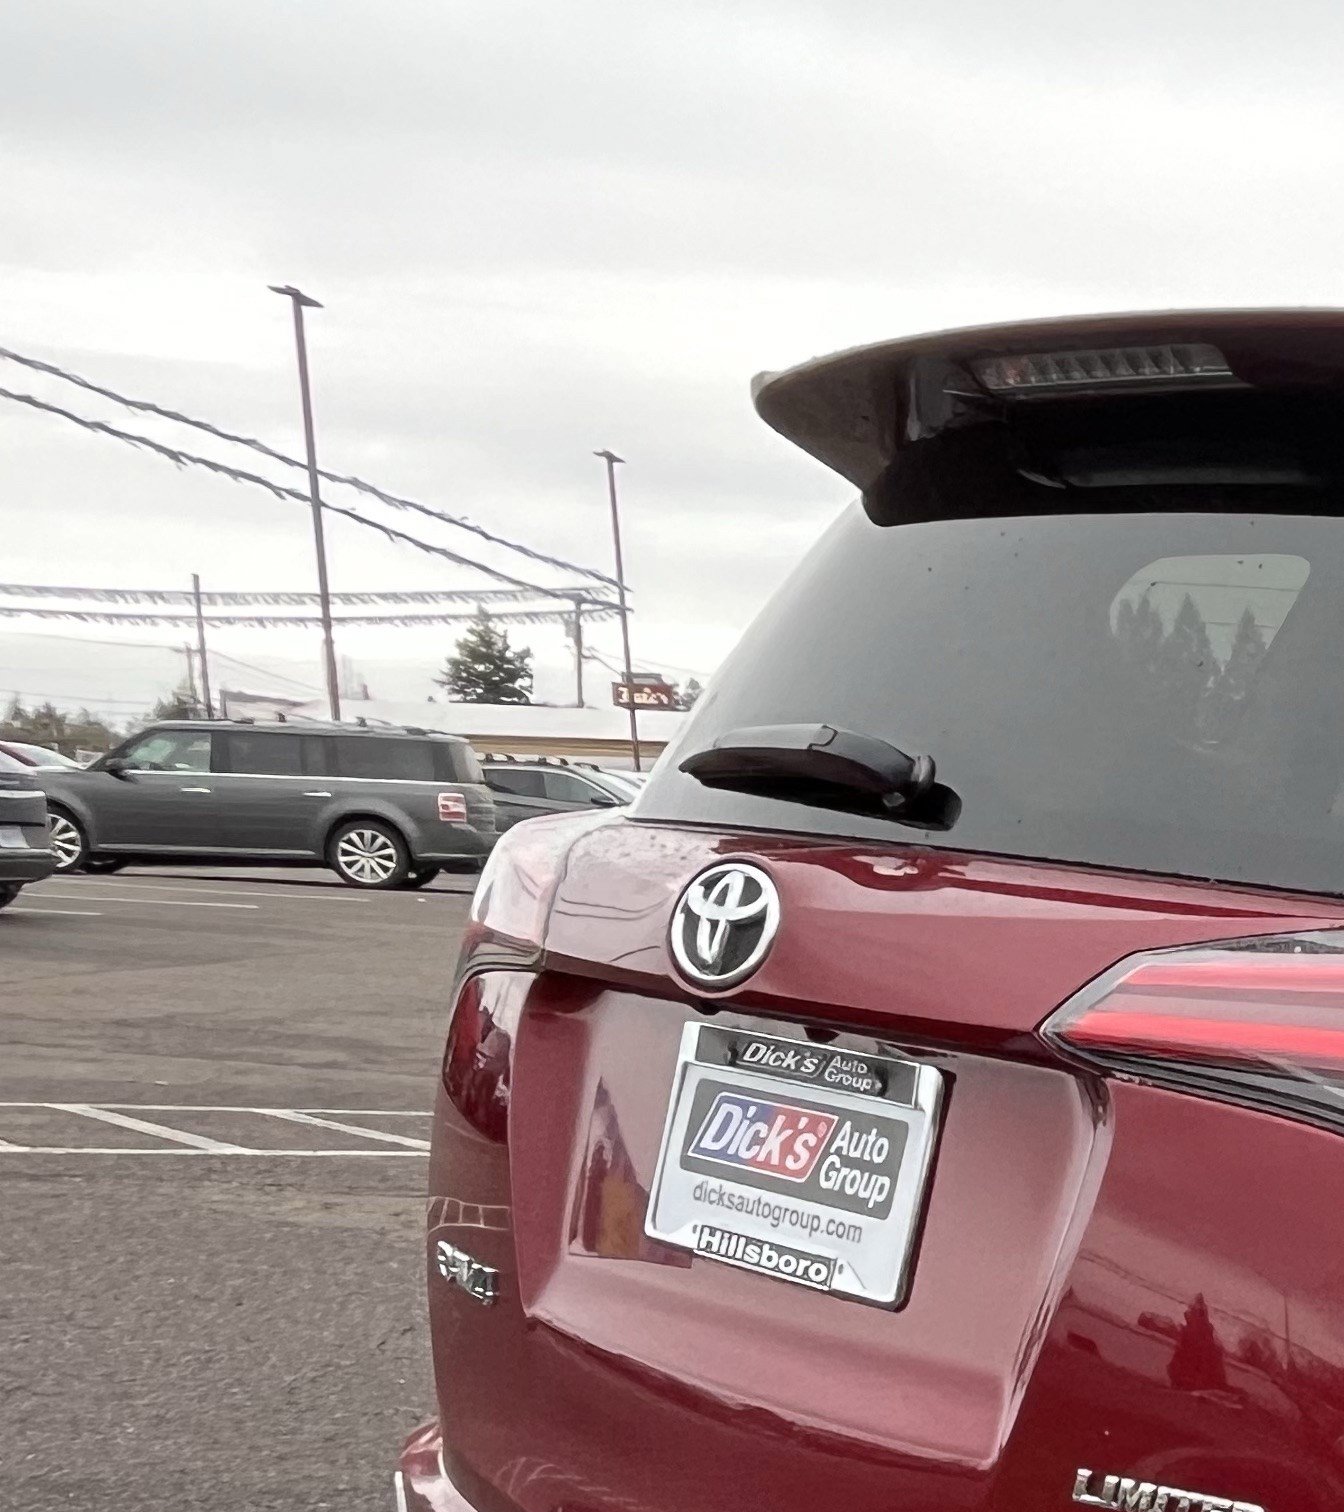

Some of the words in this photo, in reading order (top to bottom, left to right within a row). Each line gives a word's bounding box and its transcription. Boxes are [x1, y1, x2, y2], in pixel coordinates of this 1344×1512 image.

[744, 1042, 818, 1072] Dick's
[824, 1068, 873, 1091] Group
[831, 1055, 868, 1075] Auto
[700, 1103, 817, 1171] Dick's
[830, 1121, 890, 1164] Auto
[819, 1156, 891, 1209] Group
[693, 1181, 863, 1244] dicksautogroup.com
[700, 1227, 829, 1283] Hillsboro
